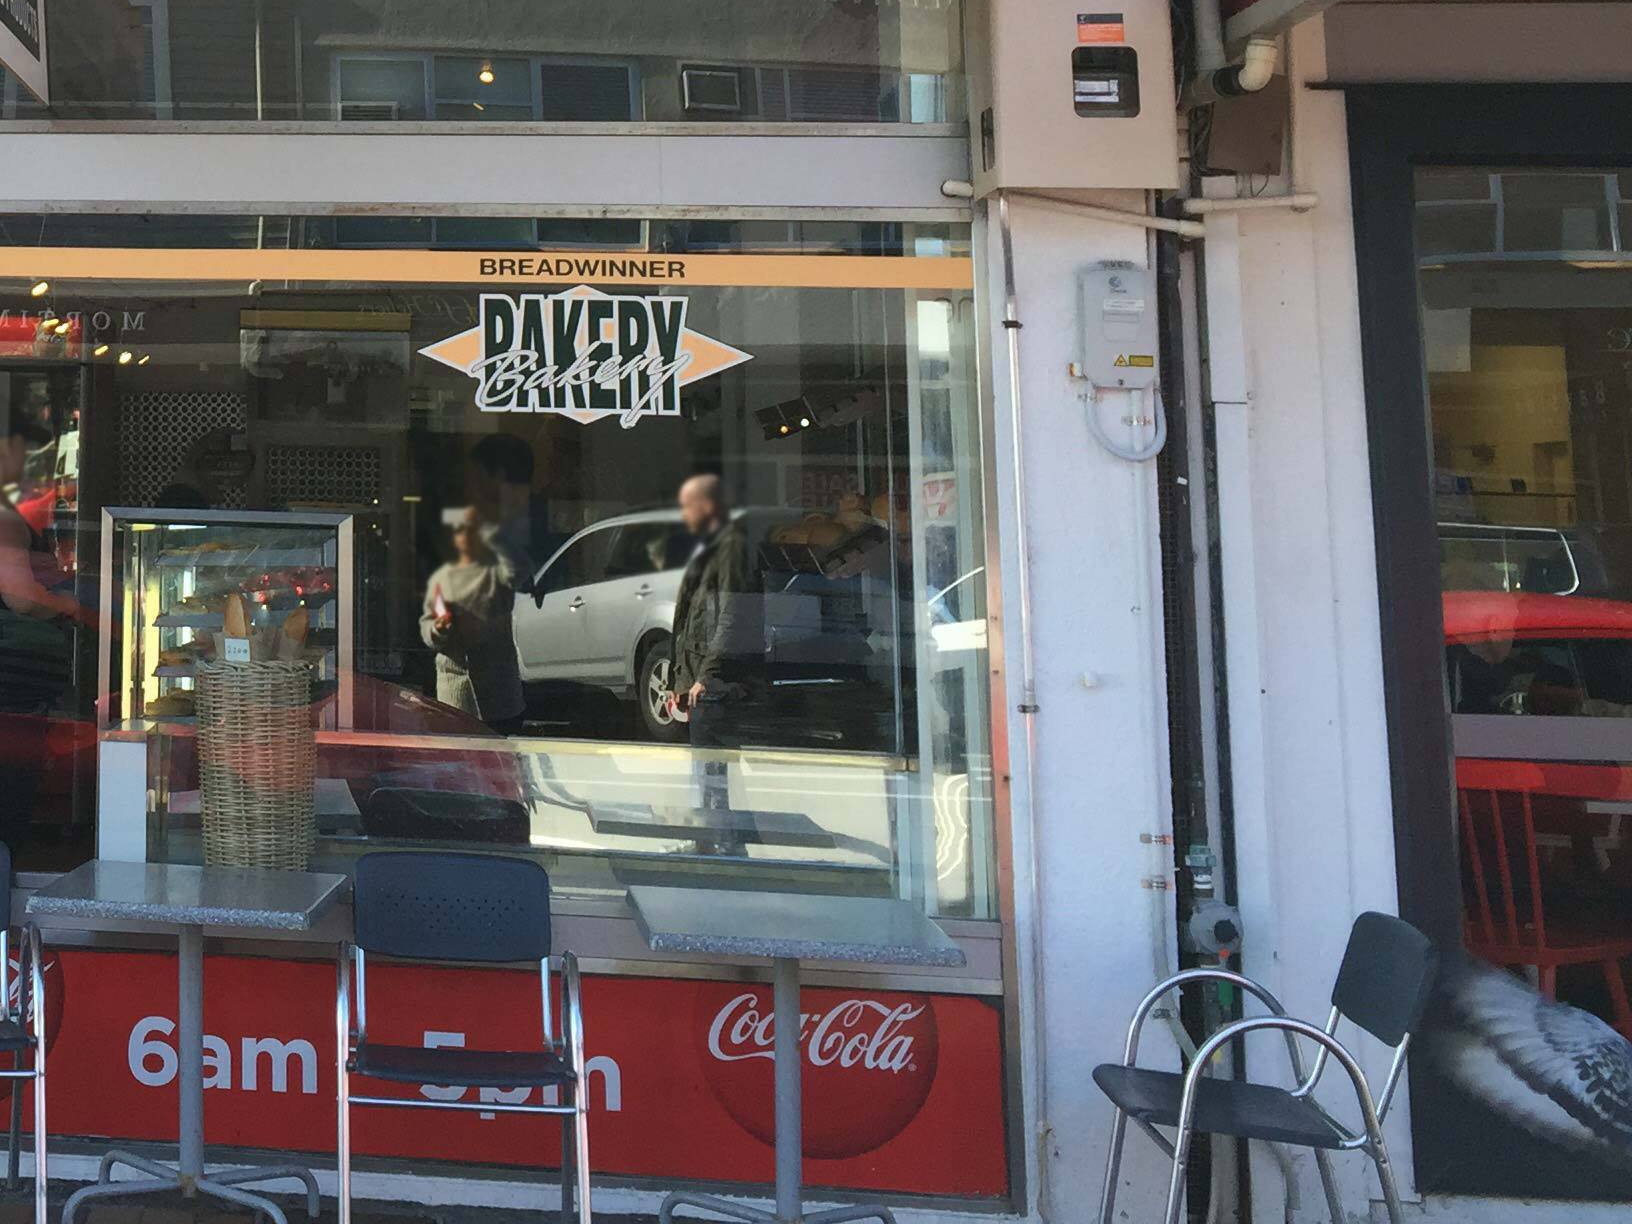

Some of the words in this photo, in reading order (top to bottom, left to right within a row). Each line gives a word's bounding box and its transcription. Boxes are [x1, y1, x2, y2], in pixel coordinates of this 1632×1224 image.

[478, 257, 686, 279] BREADWINNER
[471, 340, 690, 429] Bakery
[483, 298, 685, 411] BAKERY
[127, 1015, 318, 1095] 6am
